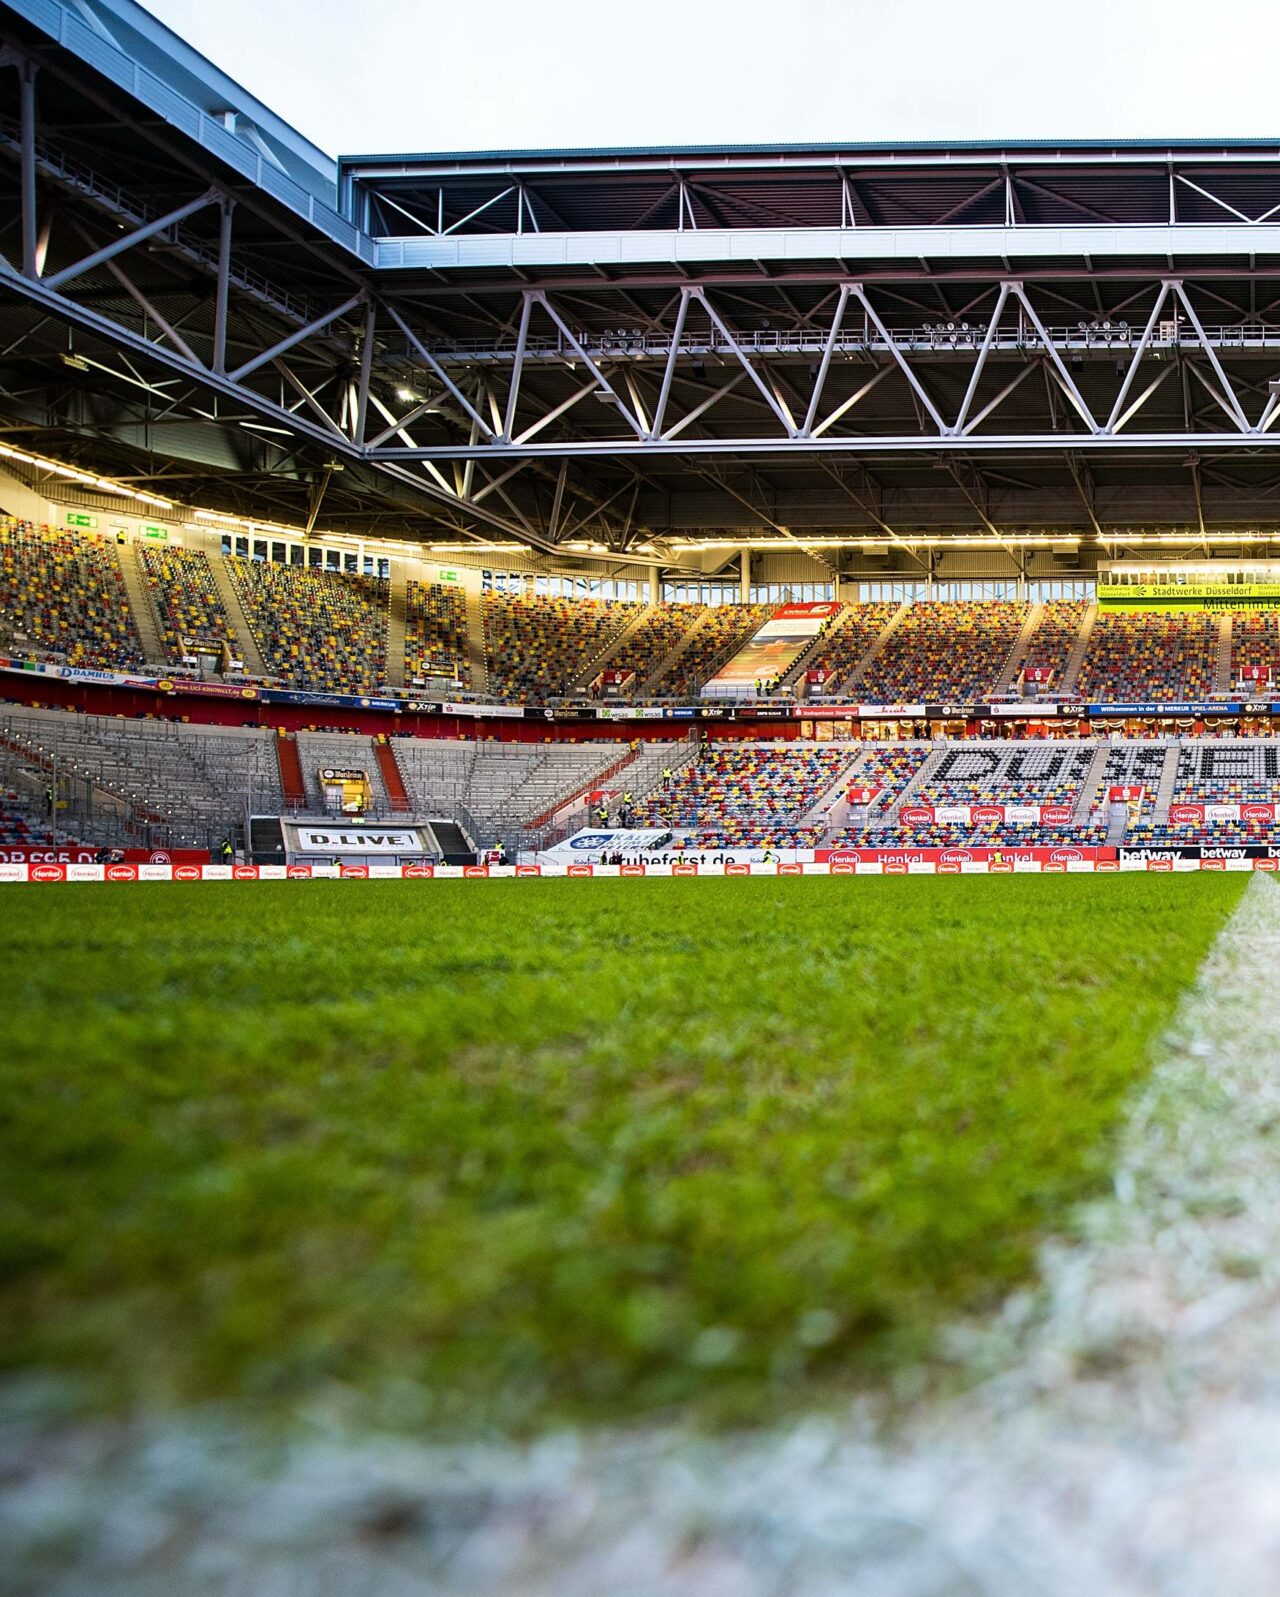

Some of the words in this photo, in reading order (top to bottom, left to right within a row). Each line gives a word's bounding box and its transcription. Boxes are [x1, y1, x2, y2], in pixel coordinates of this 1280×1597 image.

[1152, 587, 1202, 596] Stadtwerke
[1206, 586, 1252, 595] Düsseldorf
[1203, 599, 1244, 610] Mitten
[1249, 599, 1264, 609] im
[72, 669, 115, 679] DAMHUS
[975, 814, 1000, 822] Henkel
[1176, 811, 1200, 819] Henkel
[311, 834, 404, 846] D.LIVE
[943, 854, 969, 862] Henkel
[988, 853, 1033, 862] Hnkel
[1053, 853, 1080, 861] Henkel
[1120, 849, 1182, 860] betway
[1200, 848, 1247, 859] betway
[831, 855, 859, 863] Henkel
[877, 854, 923, 863] Henkel
[34, 870, 60, 878] Henkel
